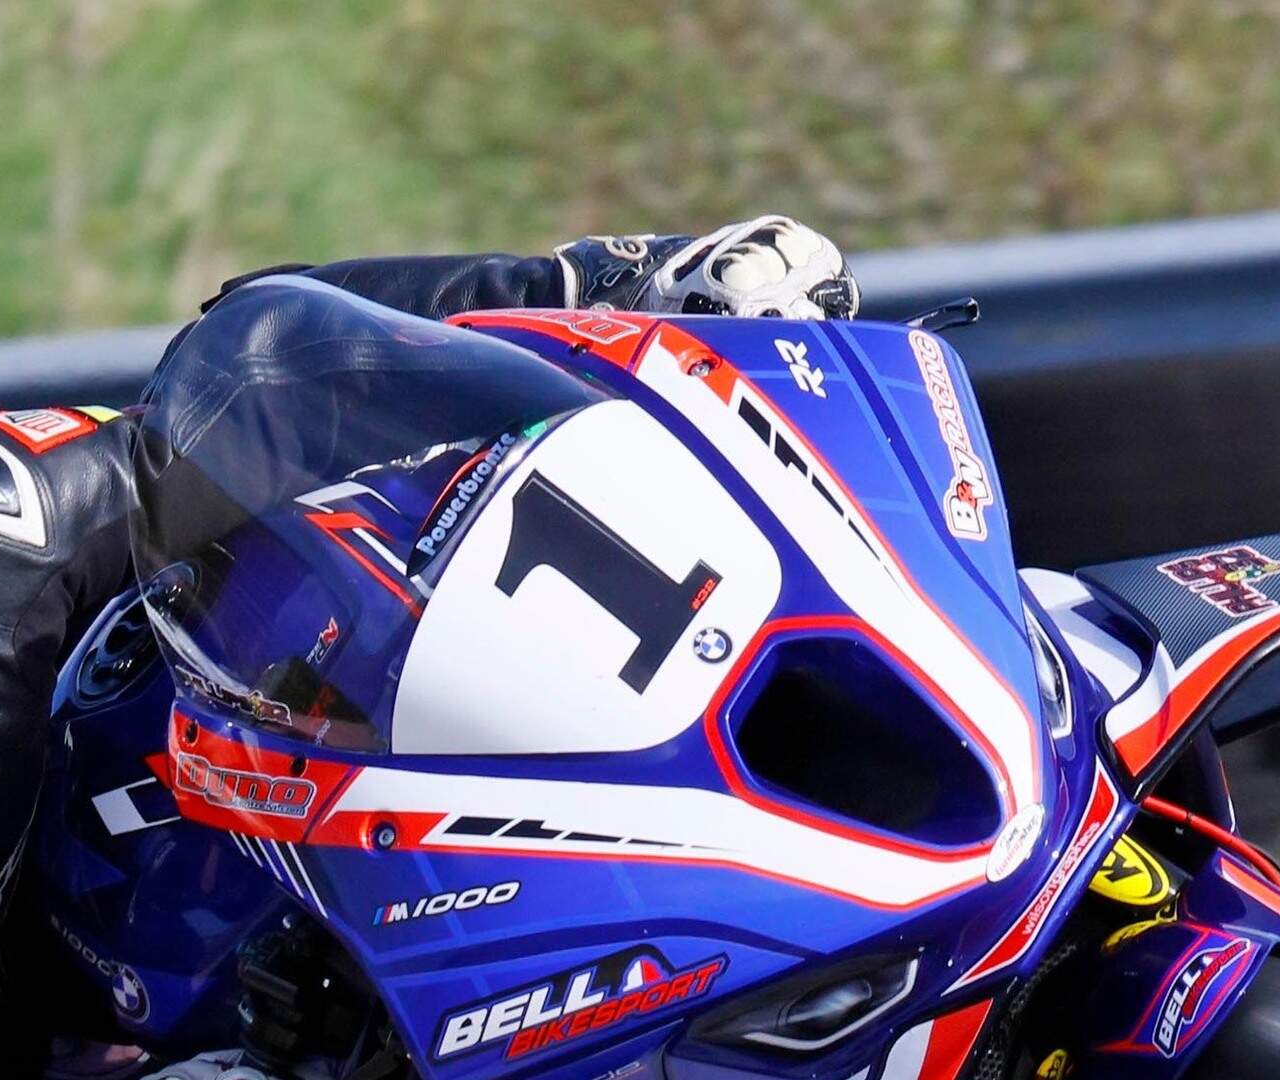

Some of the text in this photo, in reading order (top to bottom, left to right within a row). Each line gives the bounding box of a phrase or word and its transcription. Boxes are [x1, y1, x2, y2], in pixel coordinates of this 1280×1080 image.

[774, 339, 827, 399] RR
[914, 331, 970, 452] RACING
[416, 432, 516, 556] Powerbronze
[494, 468, 723, 695] 1
[438, 971, 605, 1056] BELL
[506, 961, 720, 1060] BIKESPORT
[1159, 969, 1202, 1049] BELL
